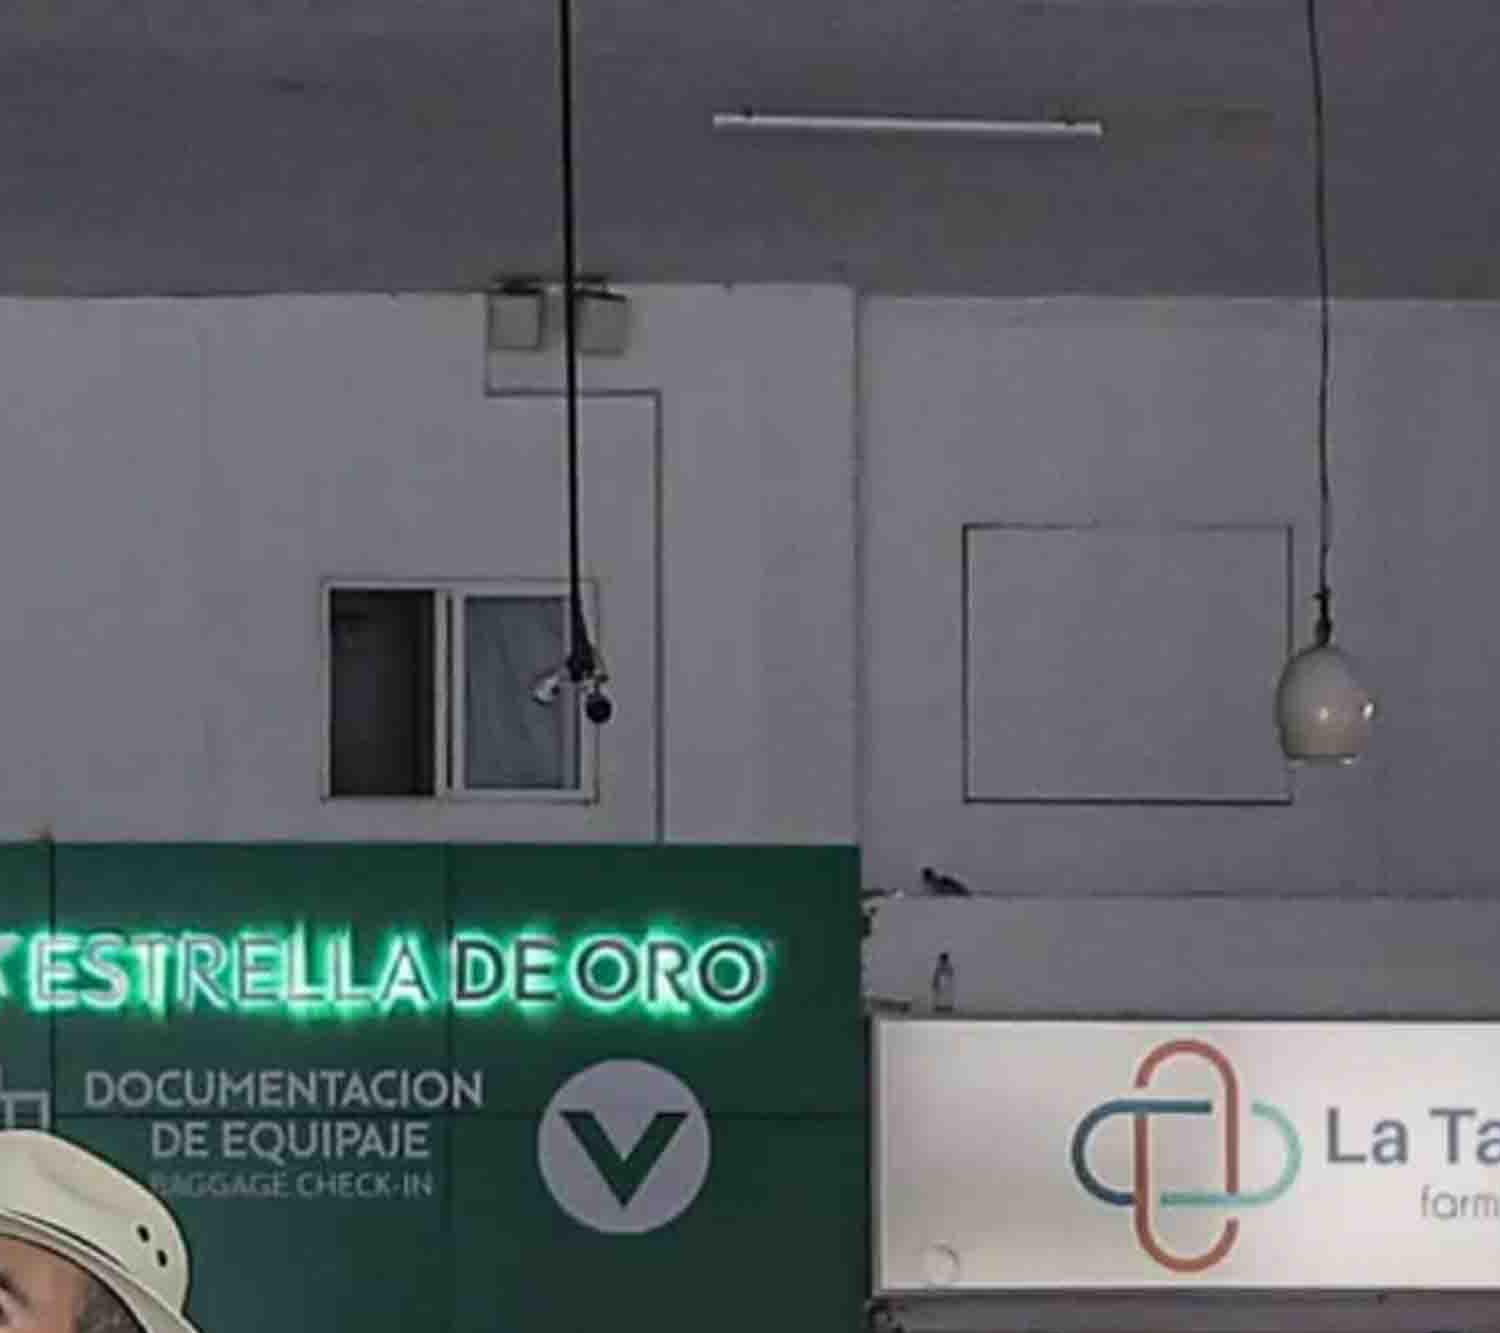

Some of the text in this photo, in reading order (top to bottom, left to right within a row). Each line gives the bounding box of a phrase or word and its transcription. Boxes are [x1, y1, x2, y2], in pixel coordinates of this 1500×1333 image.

[30, 932, 768, 1008] ESTRELLA DE ORO
[84, 1069, 484, 1111] DOCUMENTACION
[151, 1121, 432, 1166] DE EQUIPAJE
[1326, 1106, 1409, 1165] La
[296, 1171, 434, 1198] CHECK-IN
